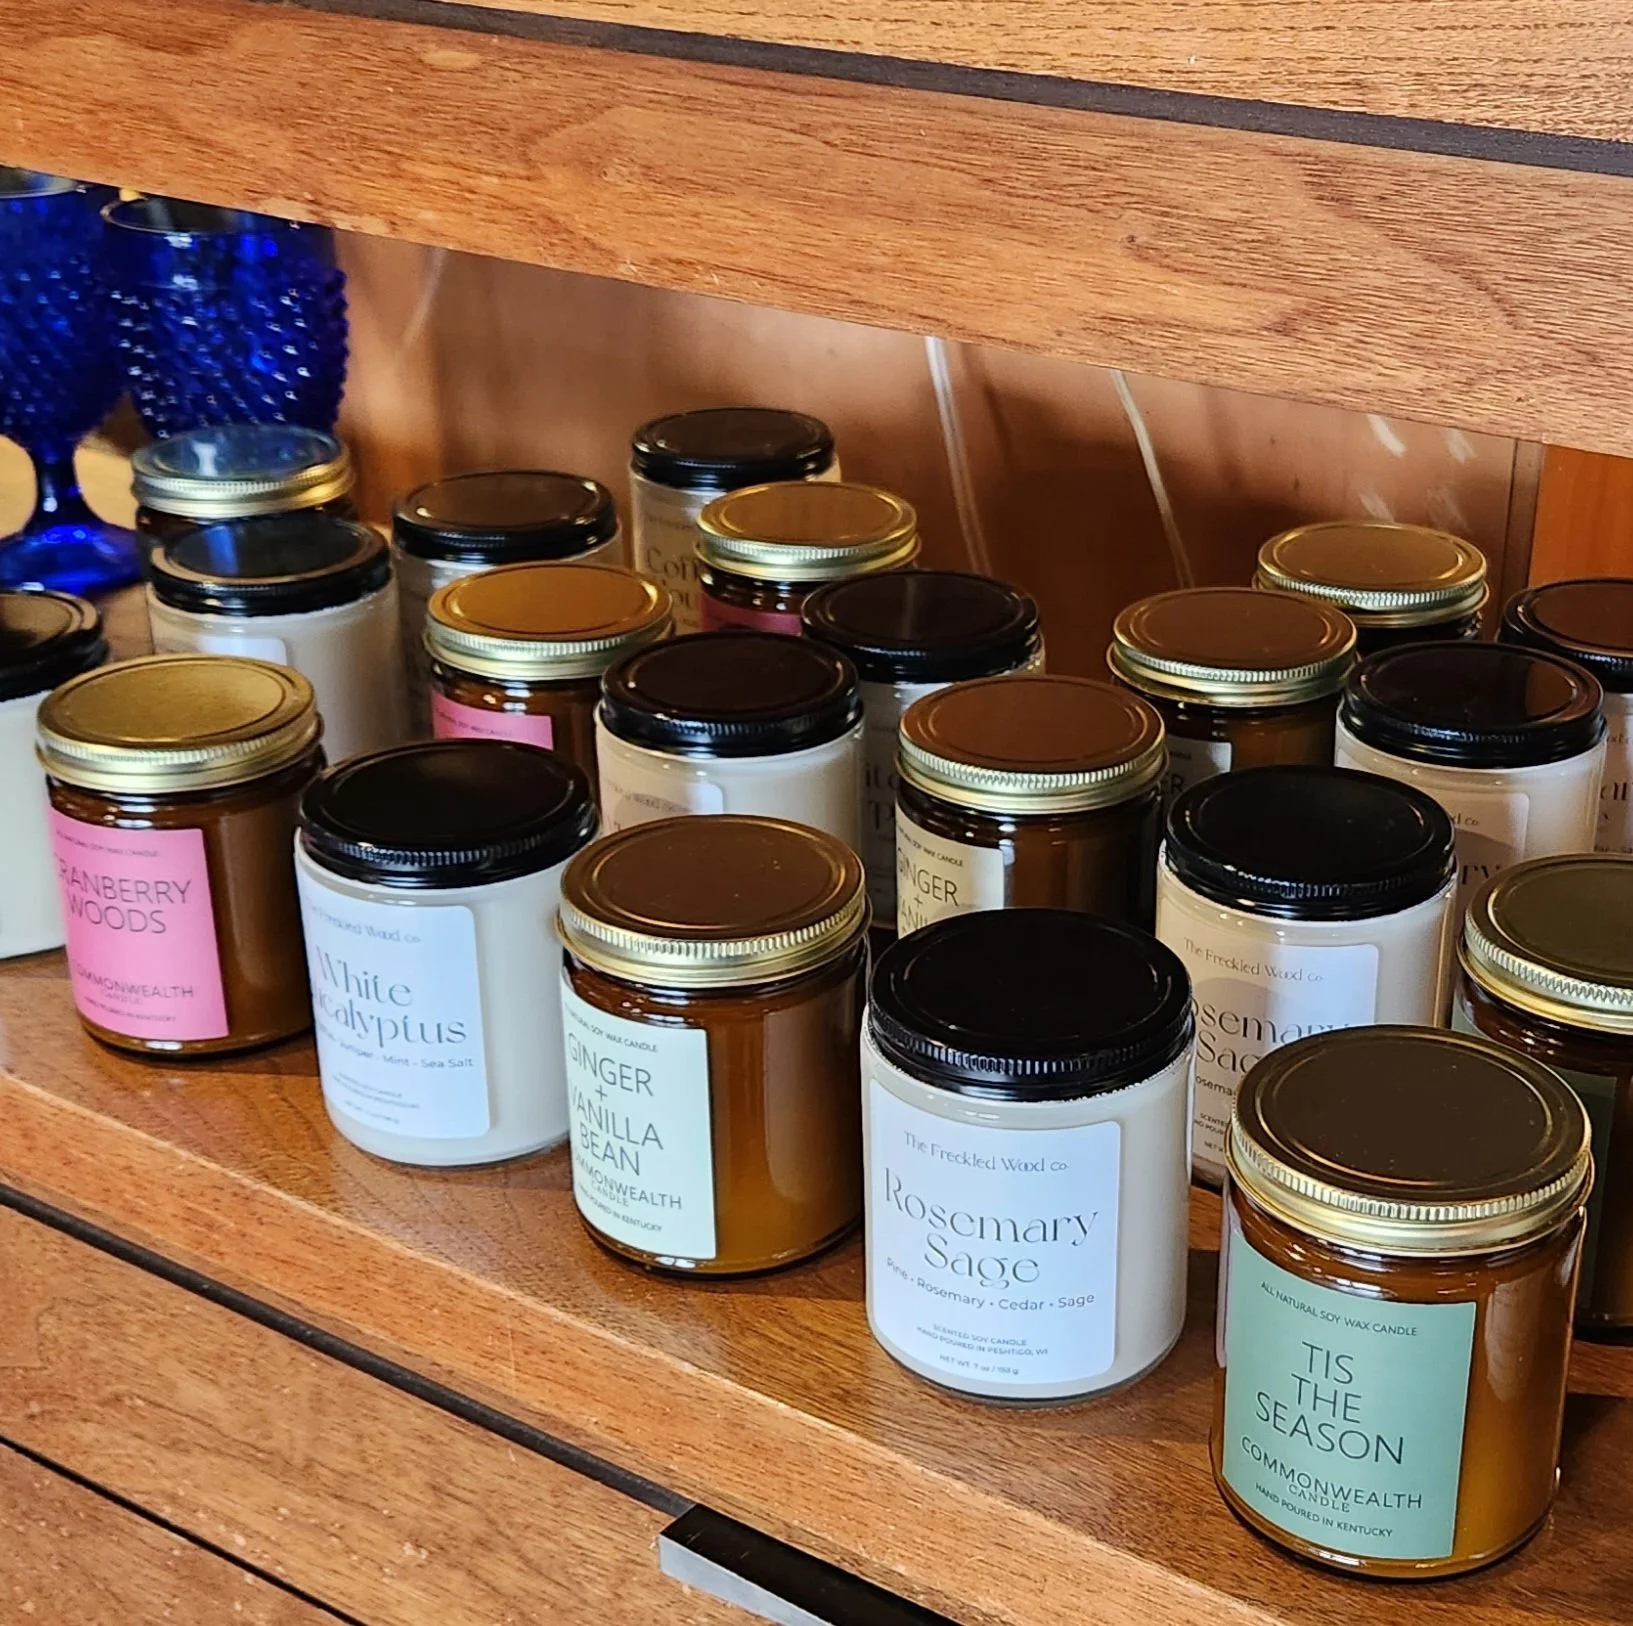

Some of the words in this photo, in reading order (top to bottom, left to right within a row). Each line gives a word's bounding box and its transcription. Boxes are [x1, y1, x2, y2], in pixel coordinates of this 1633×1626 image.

[56, 854, 191, 904] RANBERRY
[67, 892, 166, 934] WOODS
[76, 963, 193, 998] OMMONWEALTH
[448, 1056, 475, 1069] Salt
[567, 1031, 655, 1098] GINGER
[623, 1037, 659, 1053] CANDLE
[1200, 1112, 1226, 1127] SCENTE
[579, 1119, 641, 1177] BEAN
[903, 1131, 928, 1153] The
[930, 1142, 996, 1172] Freckled
[1000, 1157, 1046, 1173] Wood
[885, 1167, 1098, 1246] Rosemary
[886, 1256, 910, 1281] Pine
[916, 1277, 986, 1309] Rosemary
[998, 1297, 1046, 1311] Cedar
[1057, 1293, 1096, 1309] Sage
[923, 1232, 1041, 1291] Sage
[1260, 1280, 1276, 1297] ALL
[1275, 1293, 1318, 1317] NATURAL
[1319, 1310, 1342, 1325] SOY
[1344, 1317, 1371, 1331] WAX
[1372, 1322, 1418, 1337] CANDLE
[990, 1337, 1028, 1347] CANDLE
[1301, 1341, 1355, 1385] TIS
[1290, 1373, 1363, 1424] THE
[1255, 1391, 1405, 1465] SEASON
[1240, 1436, 1423, 1510] COMMONWEALTH
[1288, 1483, 1351, 1513] CANDLE
[1255, 1482, 1280, 1504] HAND
[1281, 1500, 1320, 1523] POURED
[1321, 1516, 1335, 1527] IN
[1336, 1521, 1394, 1538] KENTUCKY
